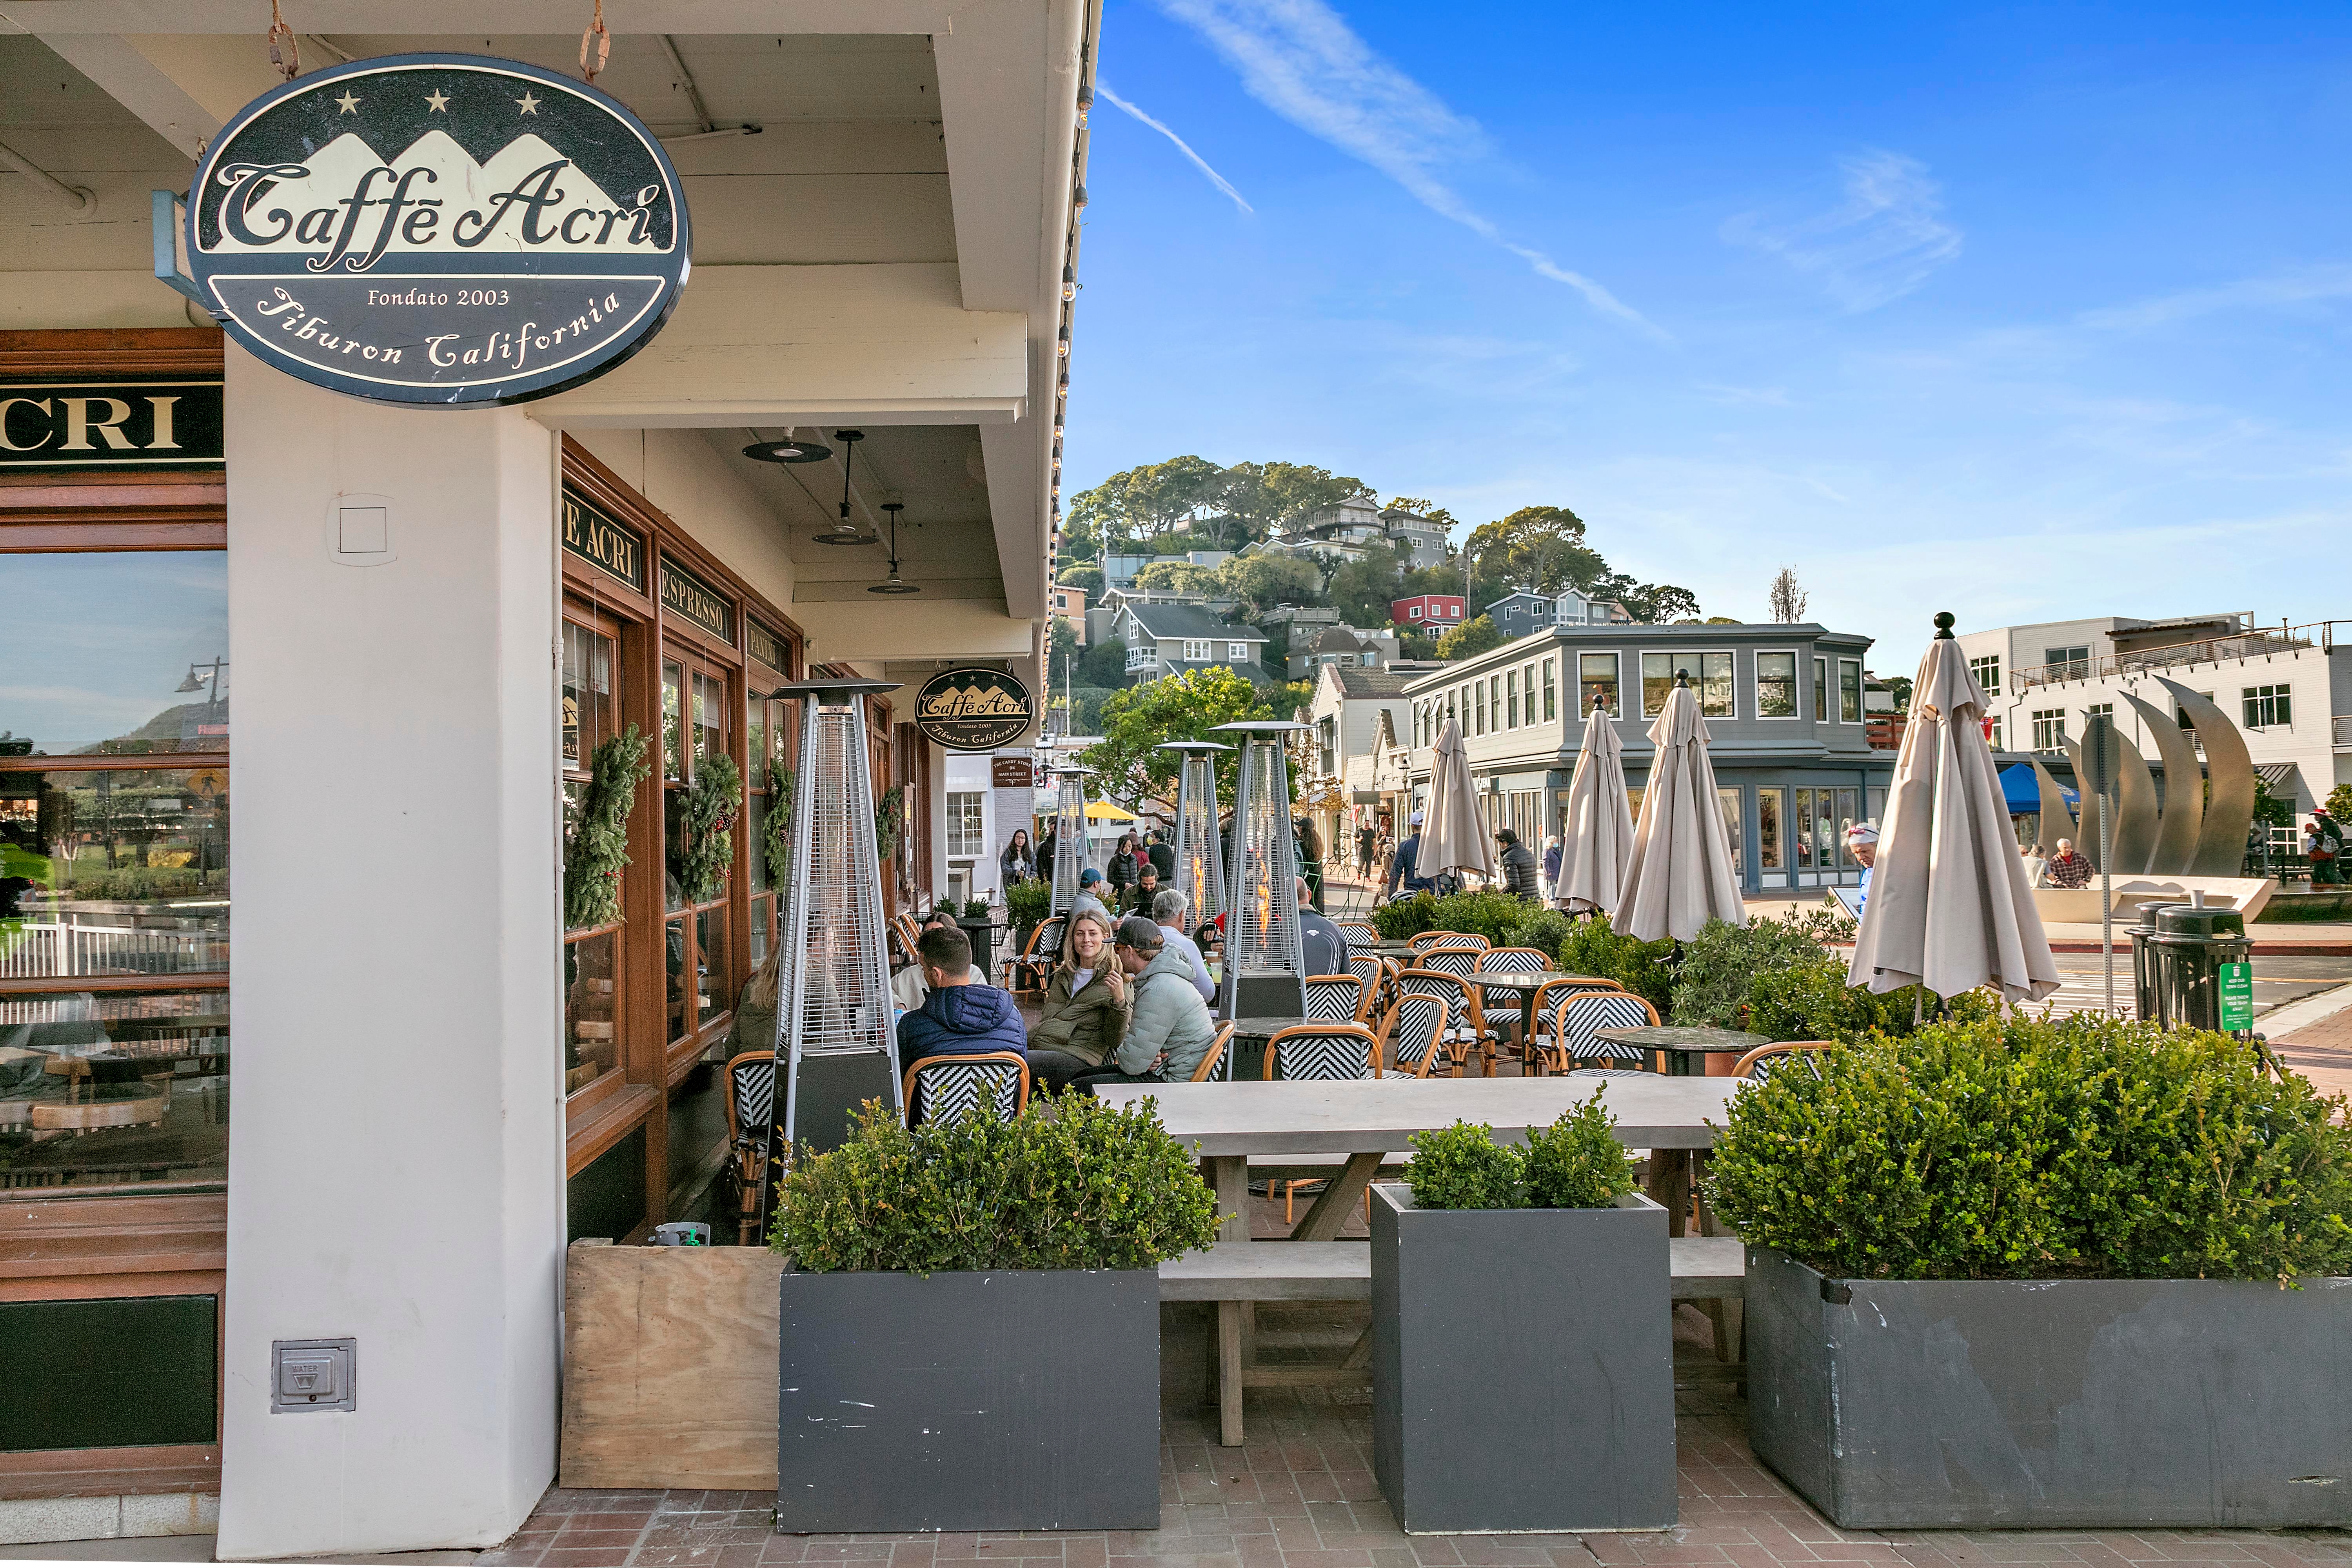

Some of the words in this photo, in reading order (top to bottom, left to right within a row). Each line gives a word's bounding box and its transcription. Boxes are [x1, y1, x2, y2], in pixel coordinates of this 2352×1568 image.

[453, 158, 659, 248] Acri
[367, 288, 448, 306] Fondato
[457, 290, 509, 306] 2003
[257, 287, 402, 364] Tiburon
[425, 292, 619, 370] California
[586, 518, 633, 579] ACRI
[661, 568, 723, 630] ESPRESSO
[750, 630, 776, 664] PANINI
[977, 691, 1026, 714] Acri
[931, 724, 967, 743] Tiburon
[971, 723, 1017, 743] California
